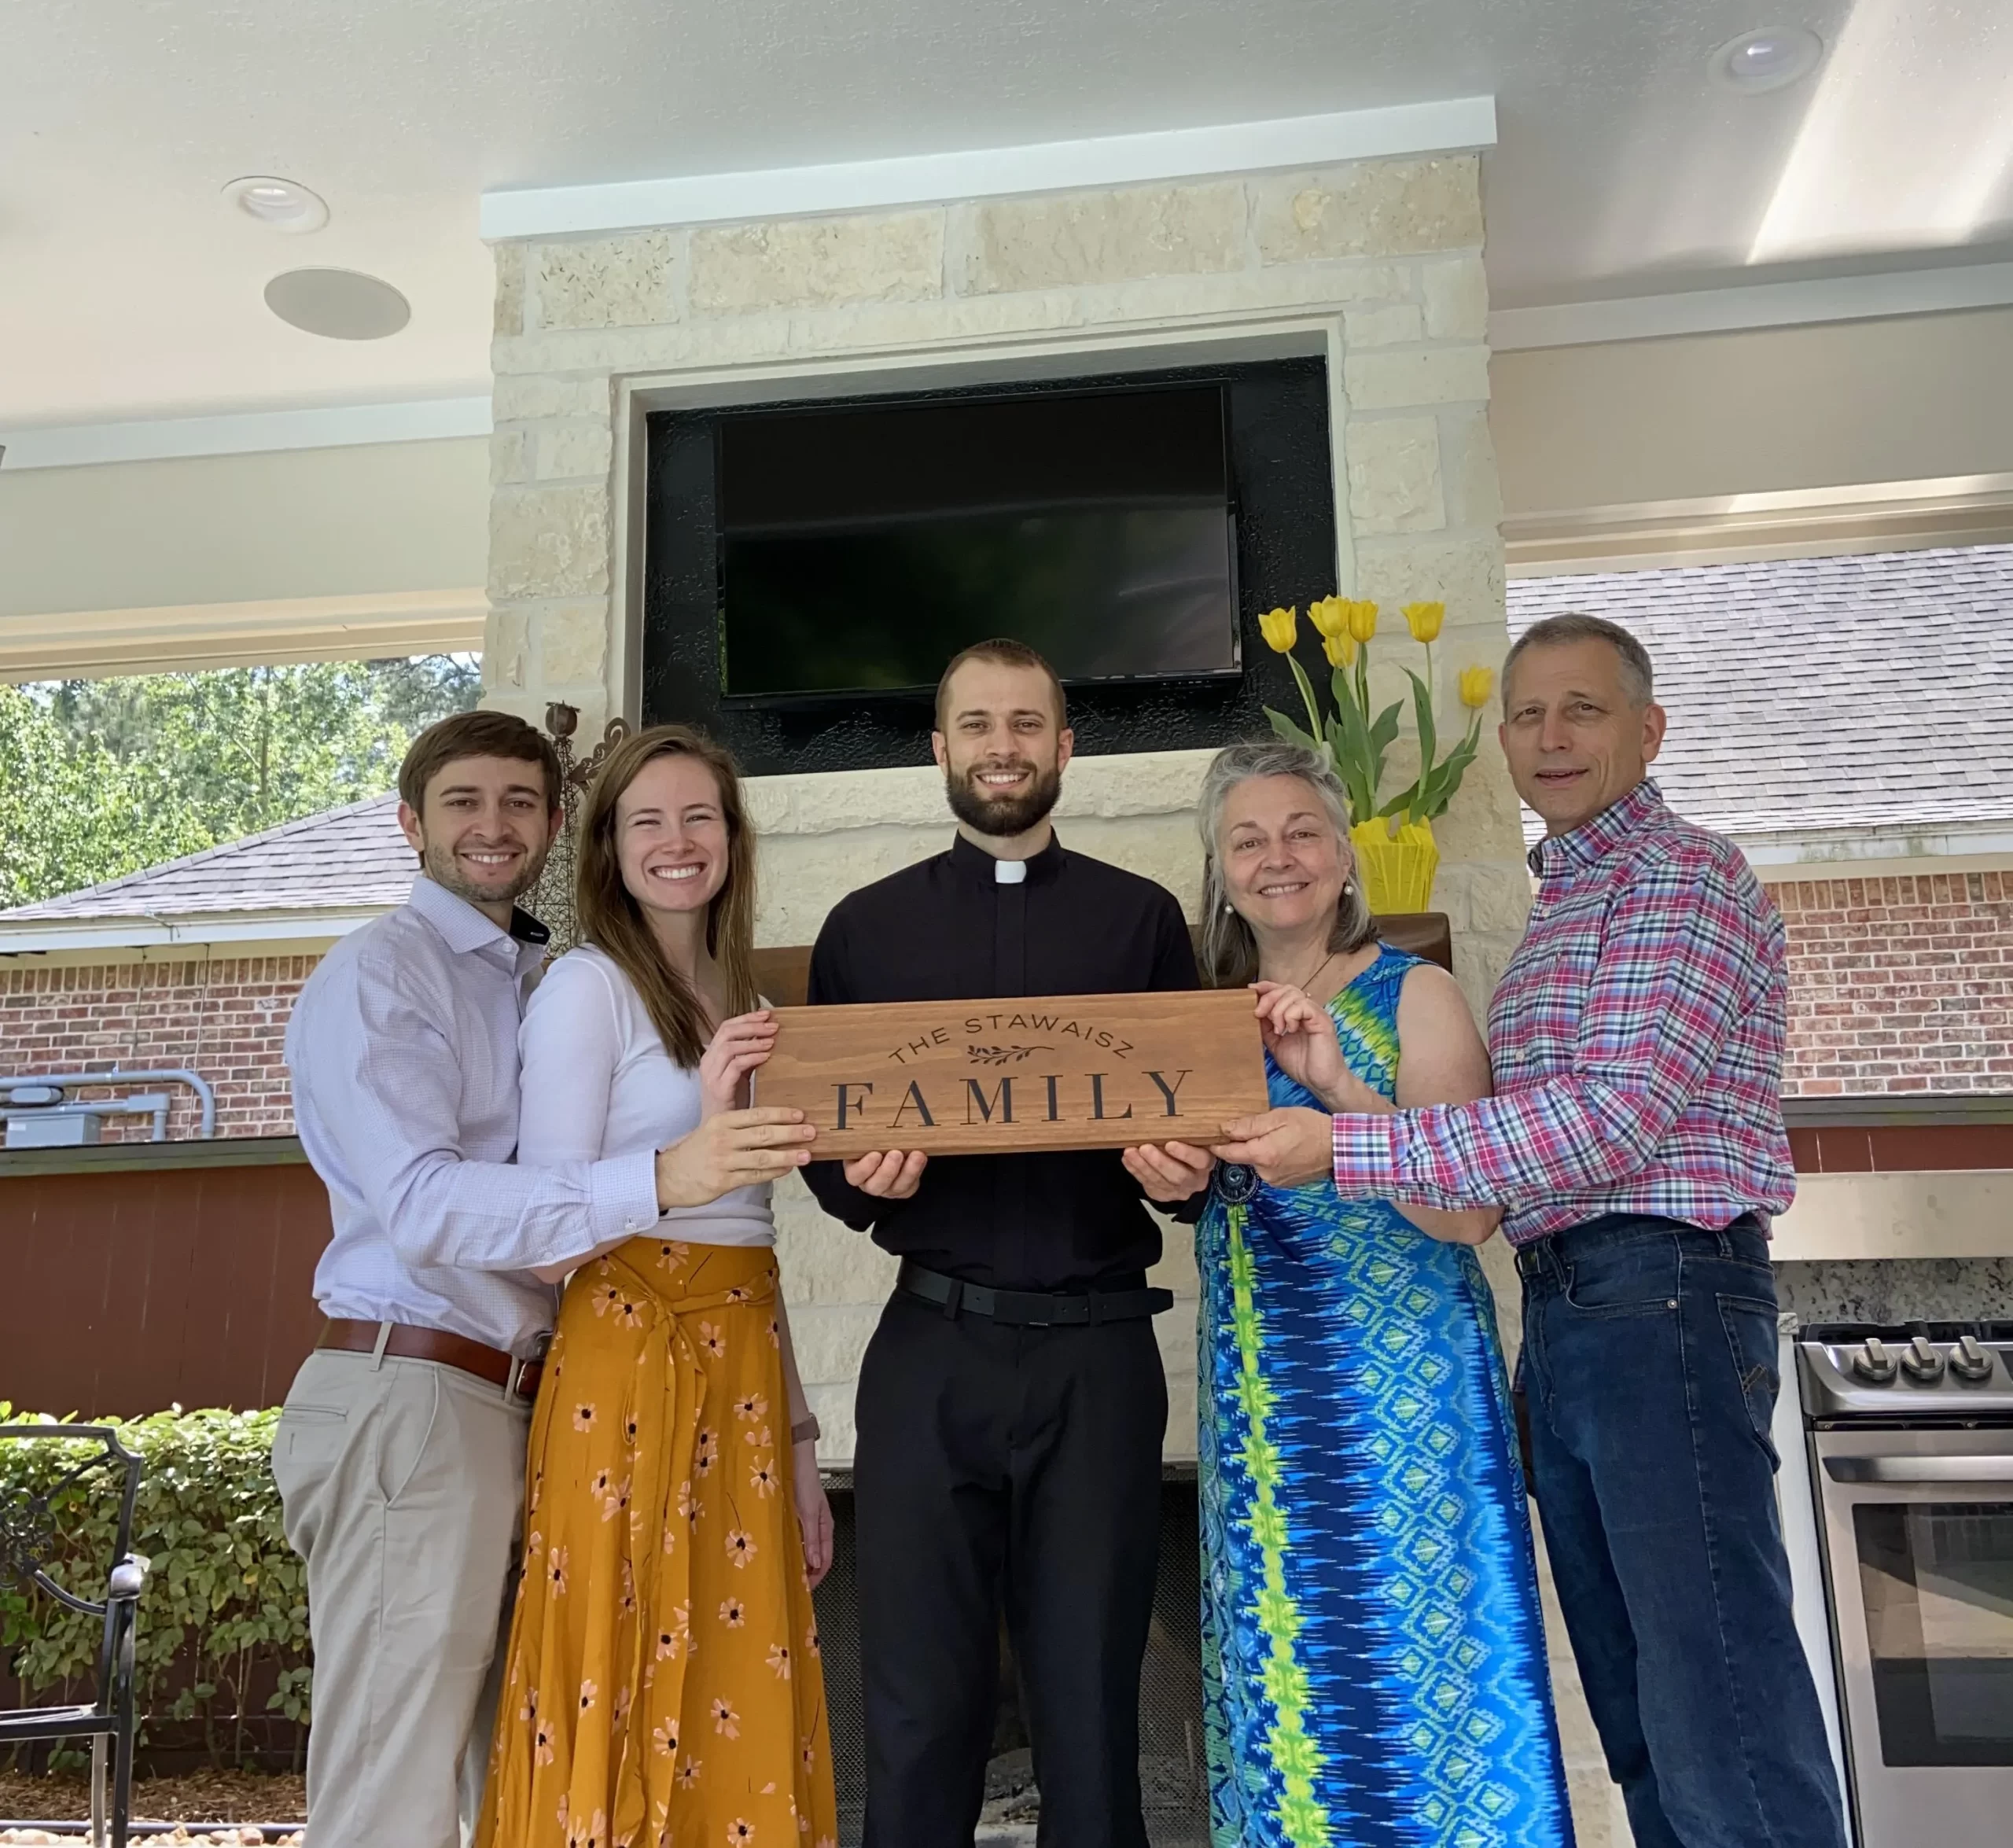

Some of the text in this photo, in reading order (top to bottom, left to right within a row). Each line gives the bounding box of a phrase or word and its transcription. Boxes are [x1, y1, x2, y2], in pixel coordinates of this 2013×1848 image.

[889, 1014, 1134, 1065] THE STAWAISZ
[830, 1069, 1193, 1130] FAMILY
